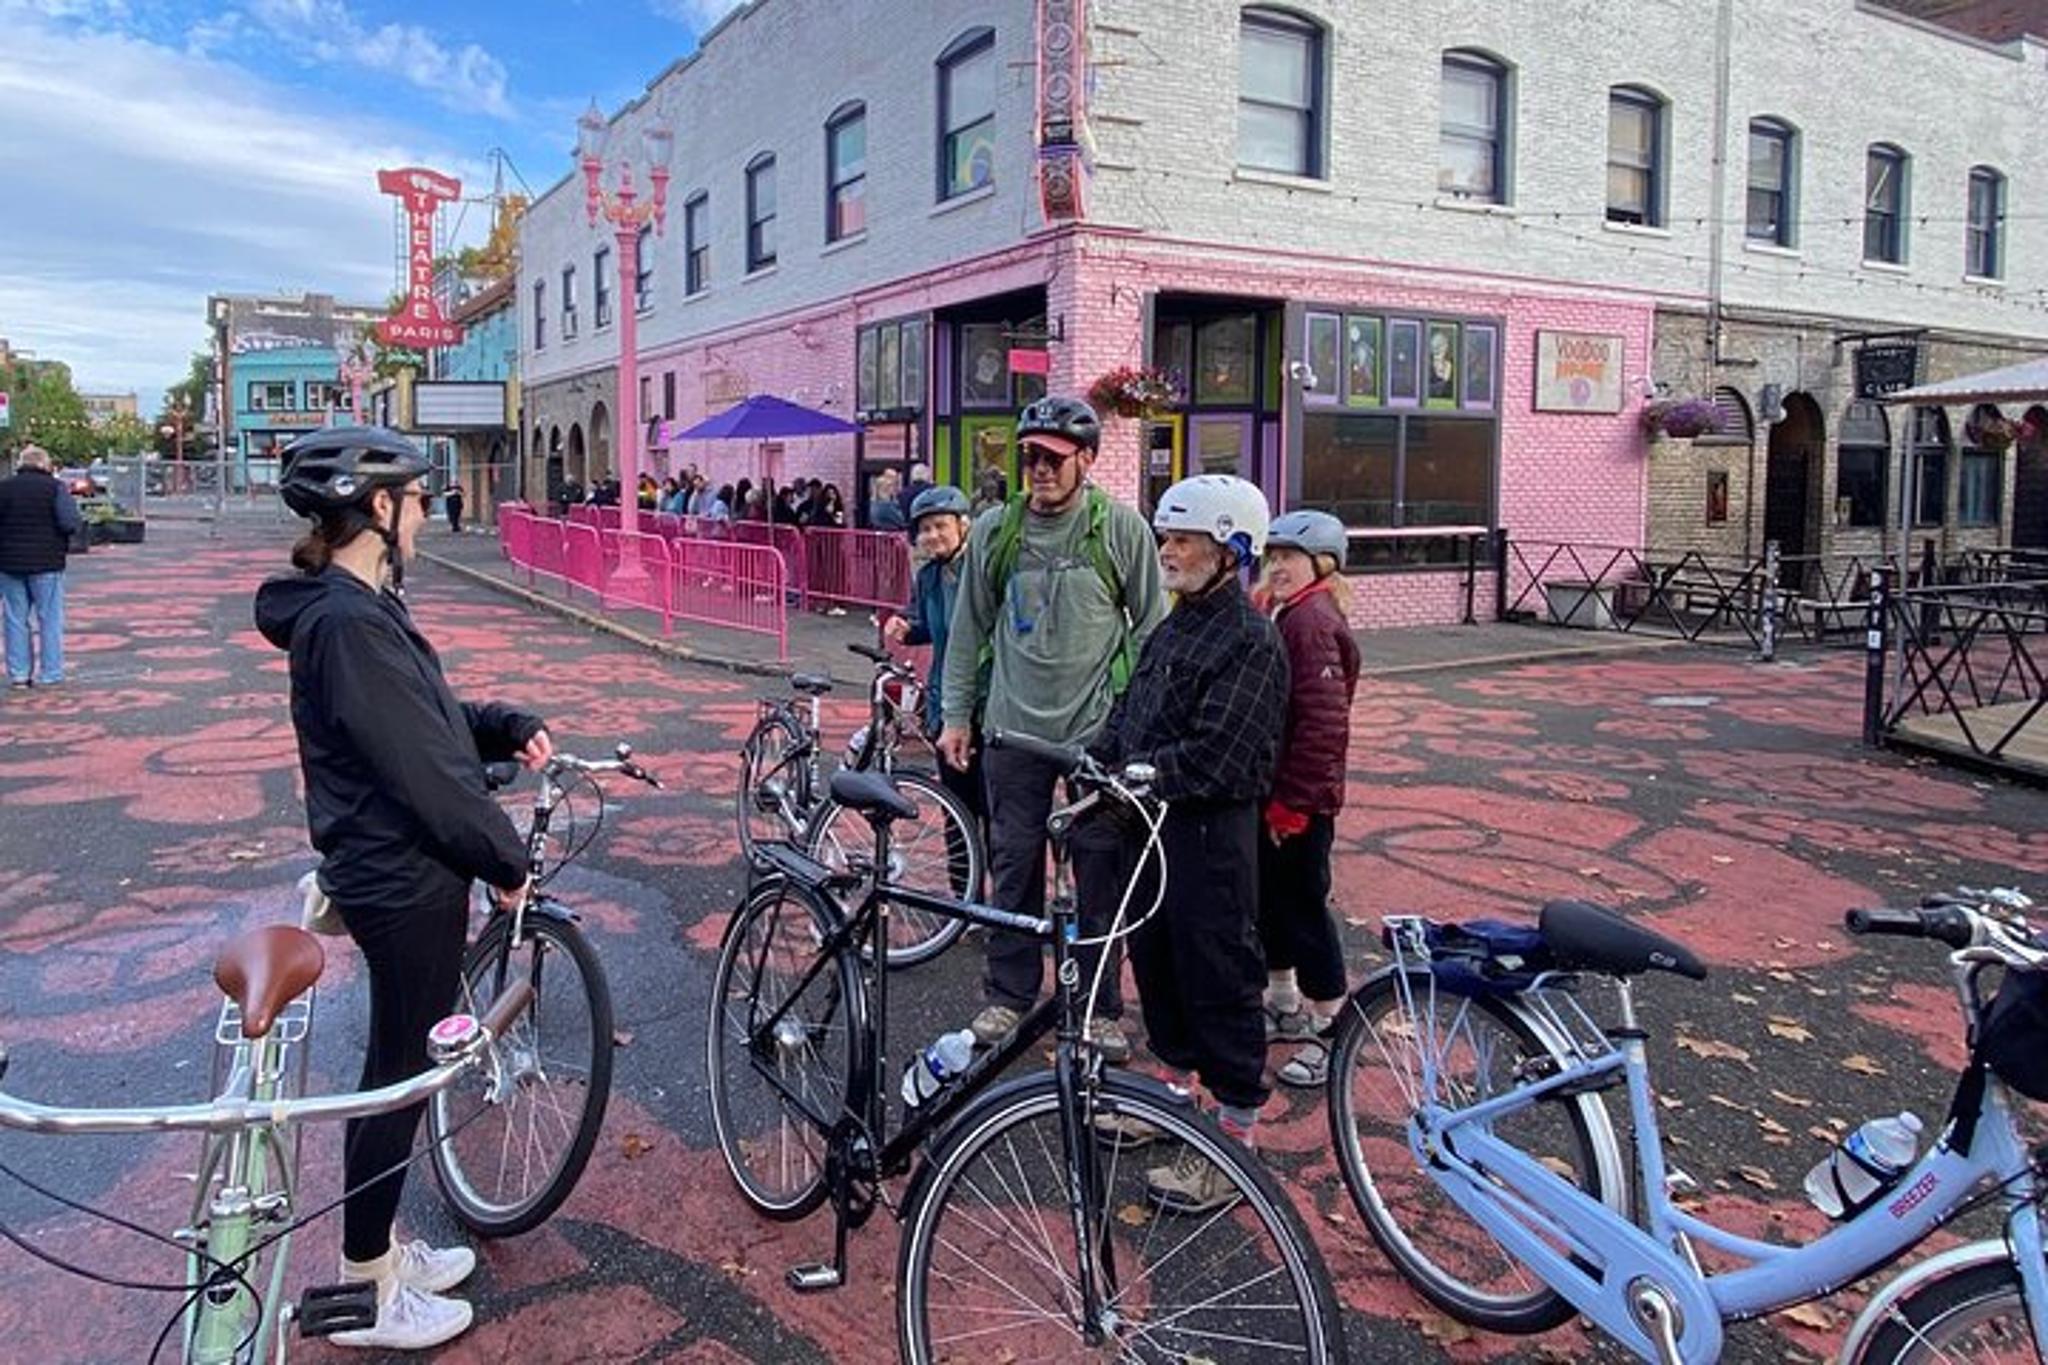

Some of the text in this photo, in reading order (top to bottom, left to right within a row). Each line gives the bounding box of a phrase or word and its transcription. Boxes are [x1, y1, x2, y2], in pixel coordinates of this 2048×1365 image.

[412, 193, 432, 320] THEATRE
[388, 325, 454, 341] PARIS
[1888, 1171, 1936, 1219] BREEZER
